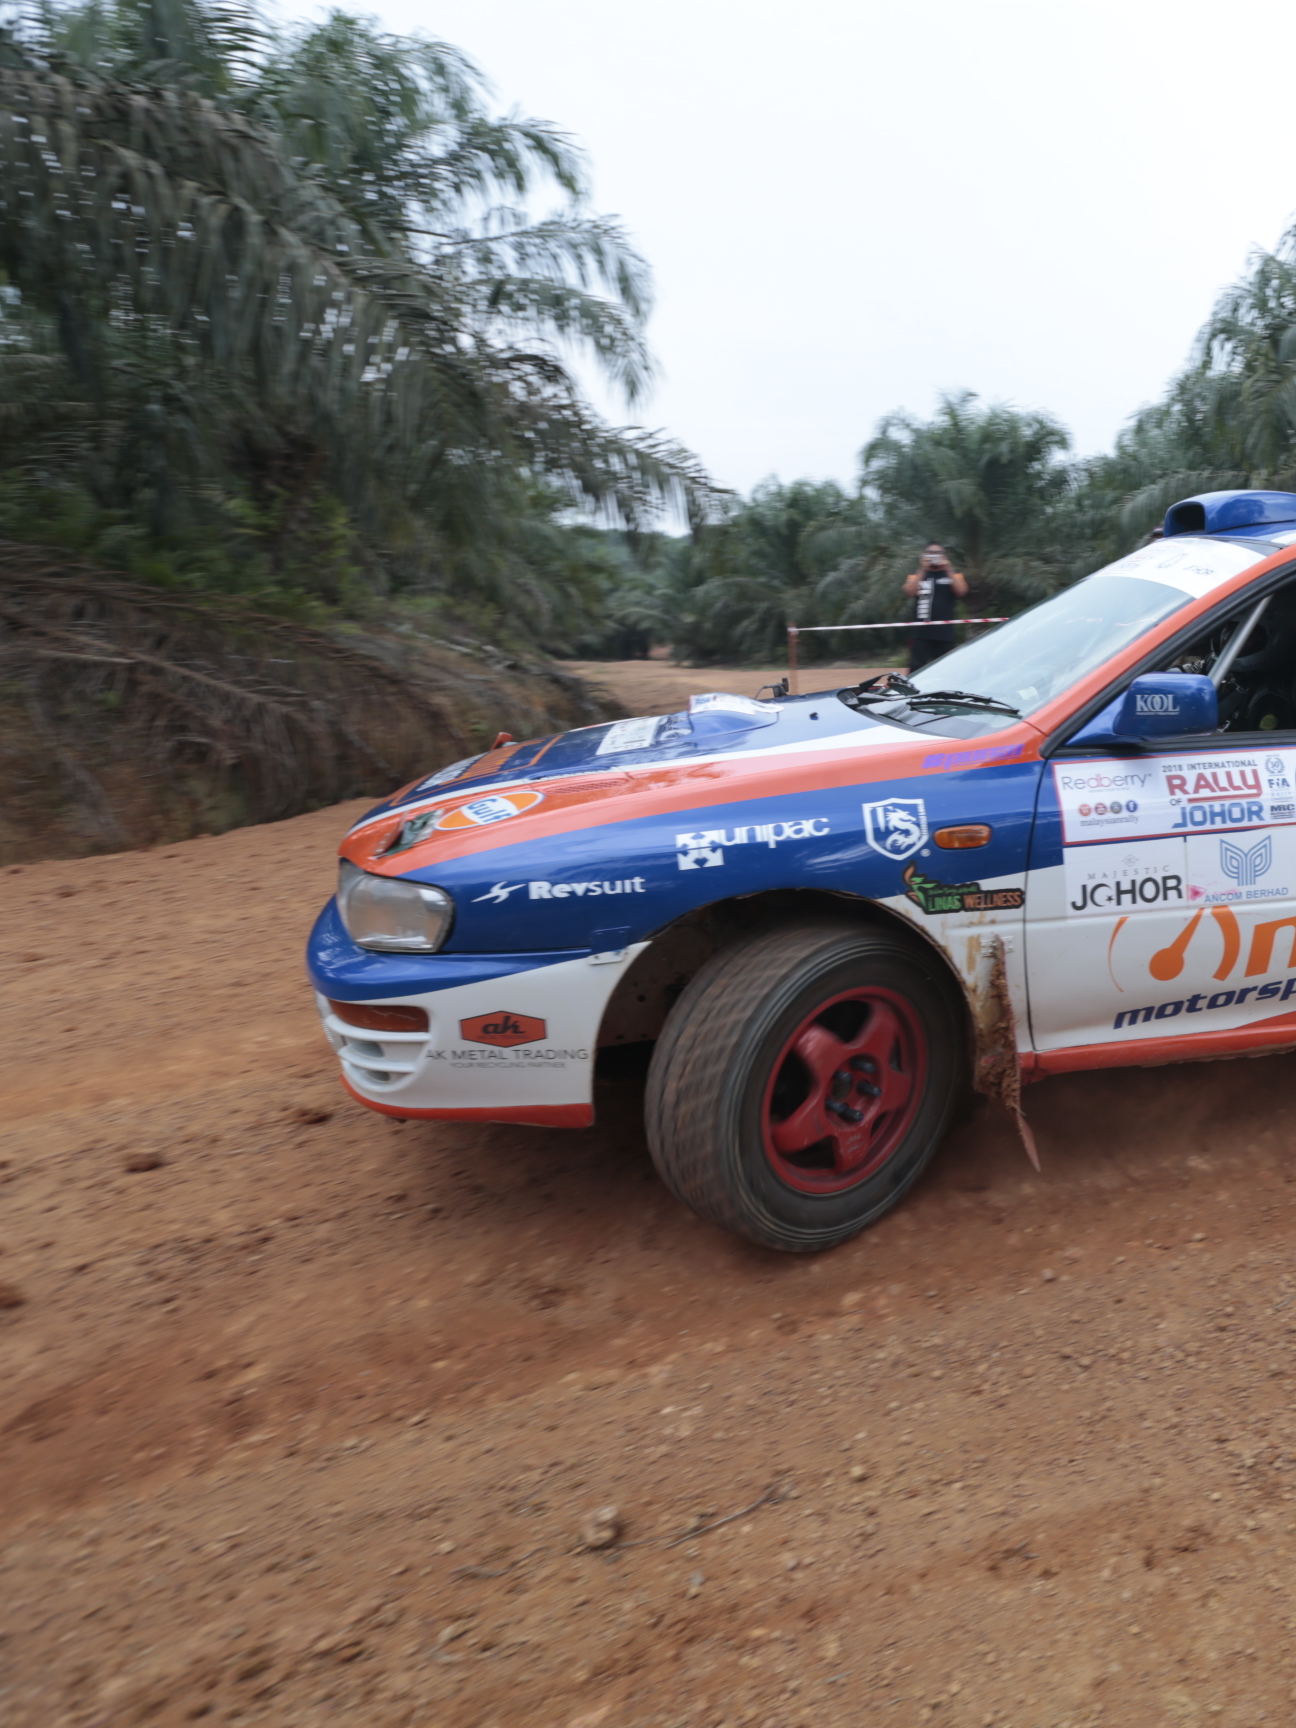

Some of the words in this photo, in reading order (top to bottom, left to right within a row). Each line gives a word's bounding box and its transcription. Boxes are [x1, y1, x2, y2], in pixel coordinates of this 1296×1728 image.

[1135, 694, 1180, 712] KOOL
[1162, 764, 1184, 774] 2018
[1187, 759, 1258, 772] INTERNATIONAL
[1061, 773, 1148, 791] Redberry
[1165, 768, 1262, 800] RALLY
[1169, 798, 1182, 806] OF
[1270, 803, 1296, 813] MRC
[468, 799, 517, 824] Gulf
[1171, 800, 1266, 828] JOHOR
[715, 817, 830, 849] unipac
[1087, 865, 1171, 881] MAJESTIC
[528, 876, 646, 900] Revsuit
[1204, 890, 1241, 904] ANCOM
[1245, 886, 1289, 900] BERHAD
[963, 891, 1023, 909] WELLNESS
[427, 1049, 448, 1060] AK
[452, 1049, 509, 1060] METAL
[511, 1048, 589, 1060] TRADING
